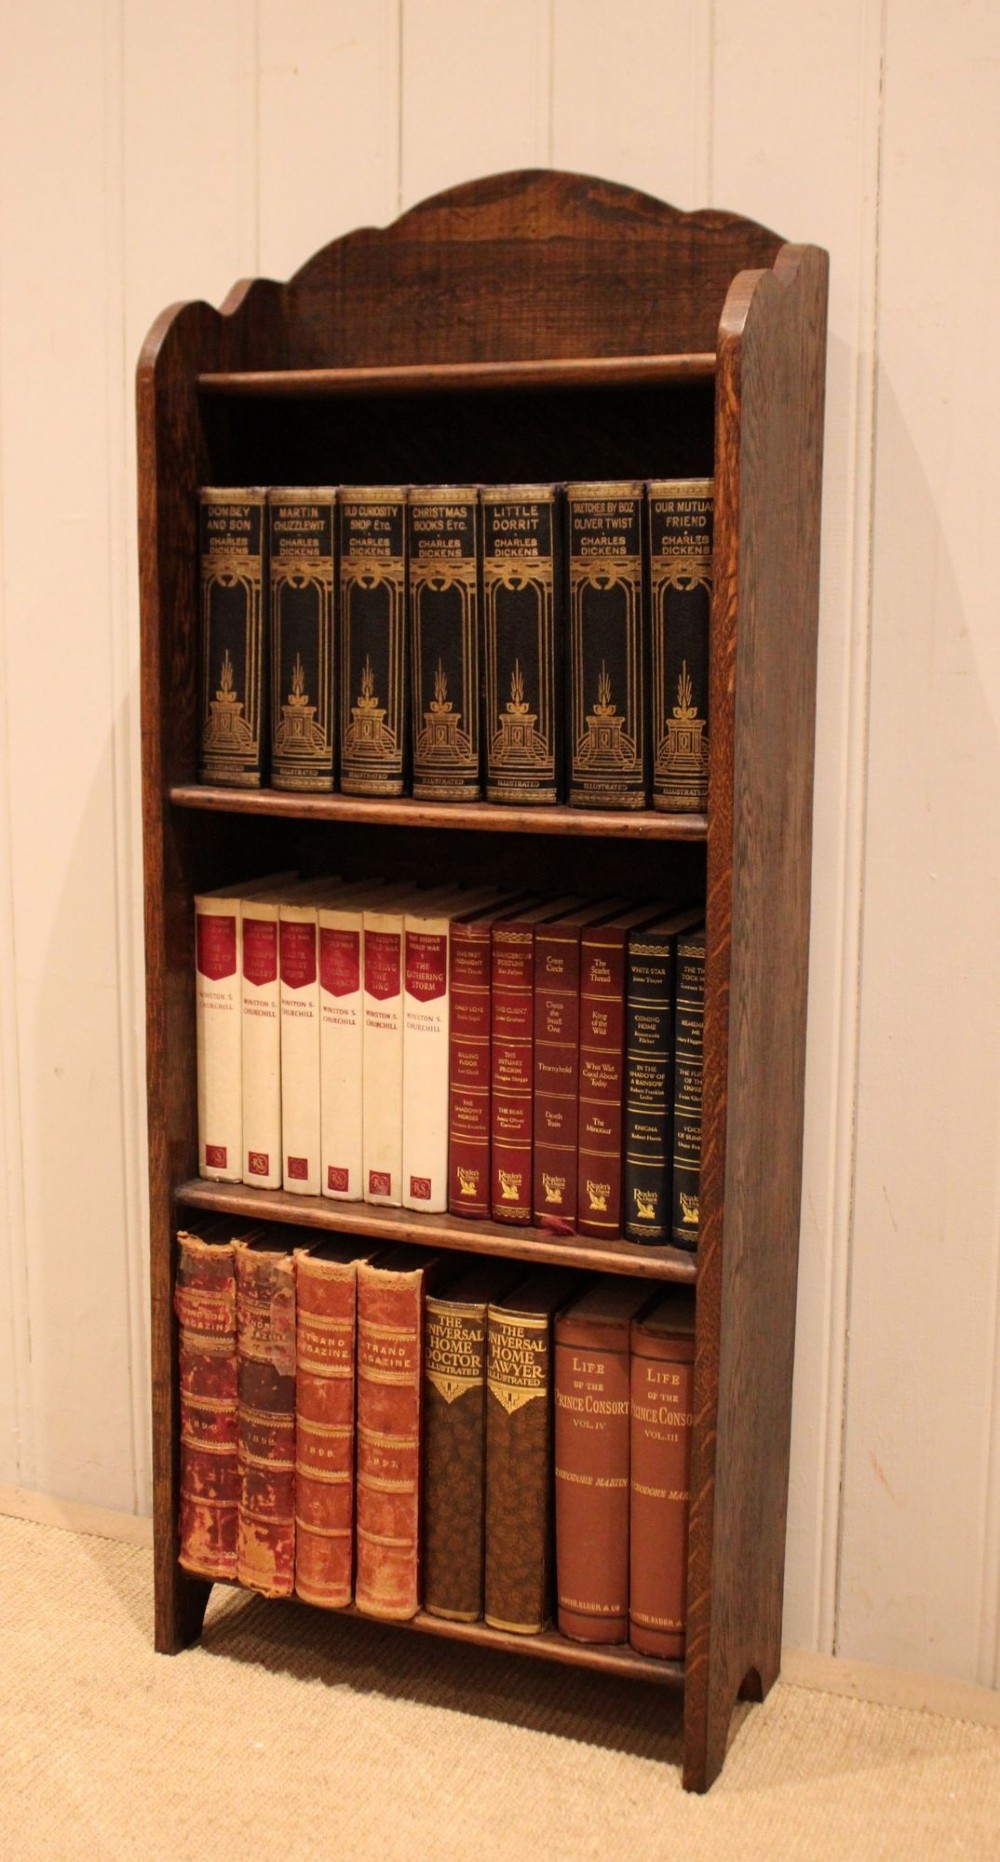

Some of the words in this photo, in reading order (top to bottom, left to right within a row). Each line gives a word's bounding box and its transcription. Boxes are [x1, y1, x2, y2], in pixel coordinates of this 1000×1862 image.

[207, 506, 250, 517] DOMBEY
[279, 507, 318, 518] MARTIN
[358, 506, 398, 517] CURIOSITY
[412, 507, 468, 518] CHRISTMAS
[493, 505, 539, 517] LITTLE
[618, 502, 634, 513] BOZ
[655, 501, 675, 513] OUR
[206, 520, 227, 531] AND
[228, 520, 251, 531] SON
[273, 520, 326, 532] CHUZZLEWIT
[350, 520, 371, 531] SHOP
[413, 520, 444, 531] BOOKS
[492, 519, 540, 531] DORRIT
[574, 517, 604, 530] OLIVER
[605, 517, 634, 529] TWIST
[666, 515, 708, 527] FRIEND
[209, 538, 248, 546] CHARLES
[279, 539, 319, 547] CHARLES
[349, 538, 391, 546] CHARLES
[418, 540, 461, 548] CHARLES
[493, 538, 539, 547] CHARLES
[580, 536, 627, 546] CHARLES
[661, 535, 710, 545] CHARLES
[209, 547, 249, 555] DICKENS
[279, 548, 320, 556] DICKENS
[349, 548, 392, 556] DICKENS
[418, 549, 462, 558] DICKENS
[494, 548, 539, 557] DICKENS
[580, 547, 627, 556] DICKENS
[662, 546, 710, 555] DICKENS
[427, 944, 440, 952] WAR
[416, 962, 431, 971] THE
[545, 964, 564, 973] Circle
[594, 959, 607, 967] The
[650, 967, 666, 975] STAR
[411, 981, 436, 991] STORM
[243, 998, 269, 1008] WINSTON
[243, 1007, 277, 1018] CHURCHILL
[323, 1005, 349, 1016] WINSTON
[366, 1009, 391, 1020] WINSTON
[592, 1011, 608, 1021] King
[323, 1015, 356, 1026] CHURCHILL
[406, 1012, 434, 1022] WINSTON
[366, 1019, 398, 1031] CHURCHILL
[406, 1021, 441, 1033] CHURCHILL
[547, 1024, 561, 1033] One
[592, 1026, 607, 1035] Wild
[637, 1022, 657, 1031] HOME
[538, 1062, 573, 1074] Thornyhold
[592, 1117, 605, 1127] The
[634, 1124, 659, 1133] ENIGMA
[438, 1314, 463, 1329] THE
[427, 1324, 485, 1342] NIVERSAL
[501, 1324, 525, 1338] THE
[429, 1335, 473, 1355] HOME
[492, 1348, 535, 1365] HOME
[573, 1380, 584, 1389] OF
[586, 1382, 604, 1392] THE
[647, 1392, 658, 1401] OF
[660, 1393, 679, 1404] THE
[585, 1395, 630, 1416] CONSORT
[658, 1407, 693, 1429] CONSO
